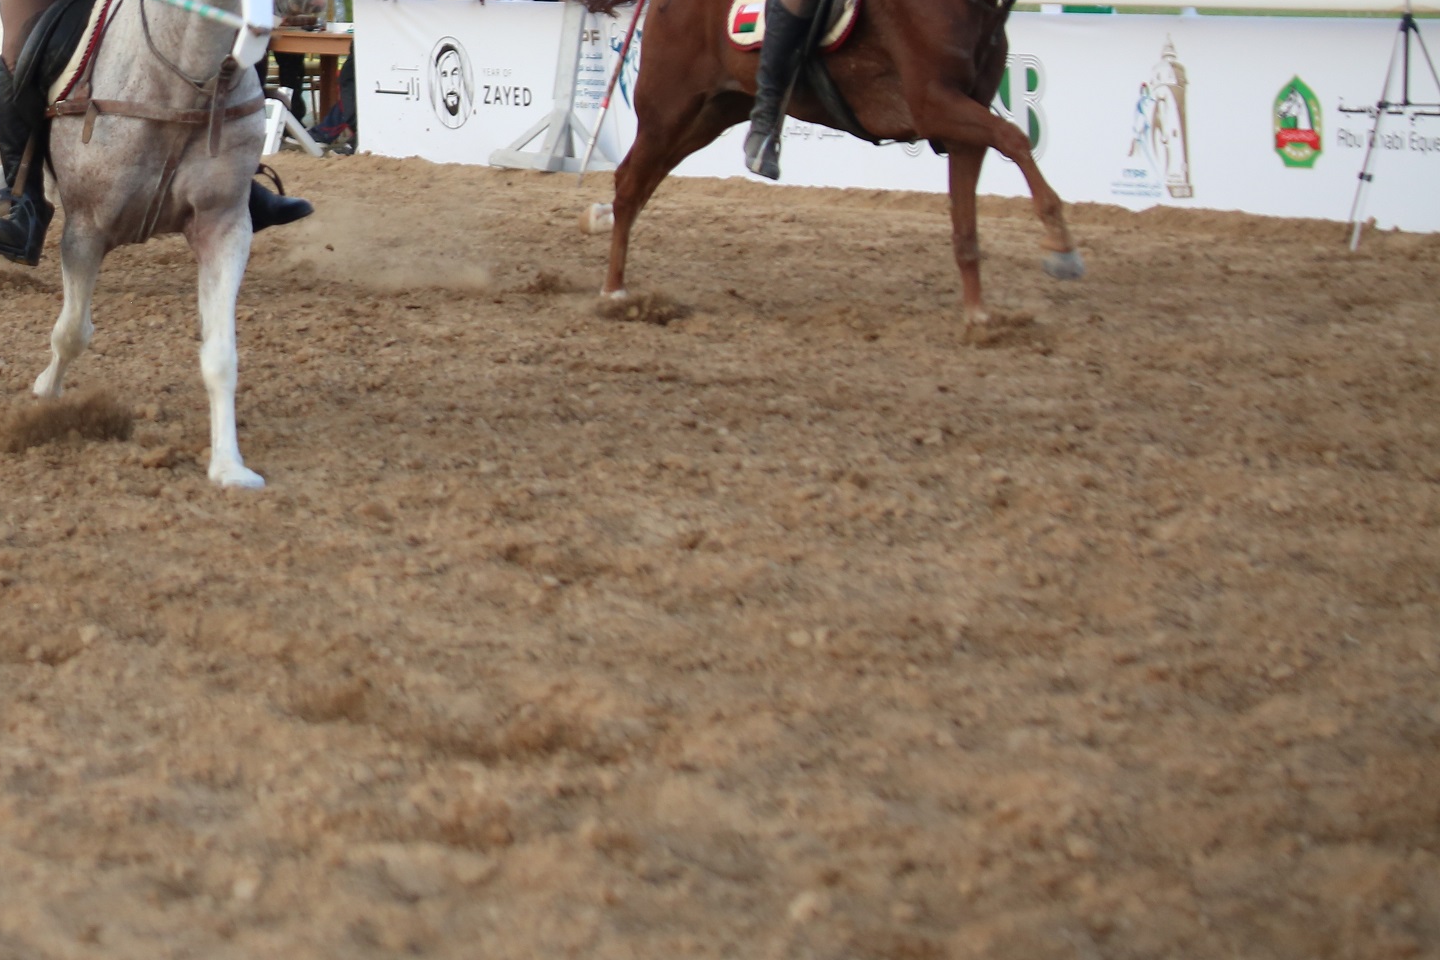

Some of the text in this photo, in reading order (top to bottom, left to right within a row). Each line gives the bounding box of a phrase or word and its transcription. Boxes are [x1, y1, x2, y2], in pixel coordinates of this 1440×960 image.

[482, 67, 513, 78] YEAR OF
[483, 85, 533, 108] ZAYED
